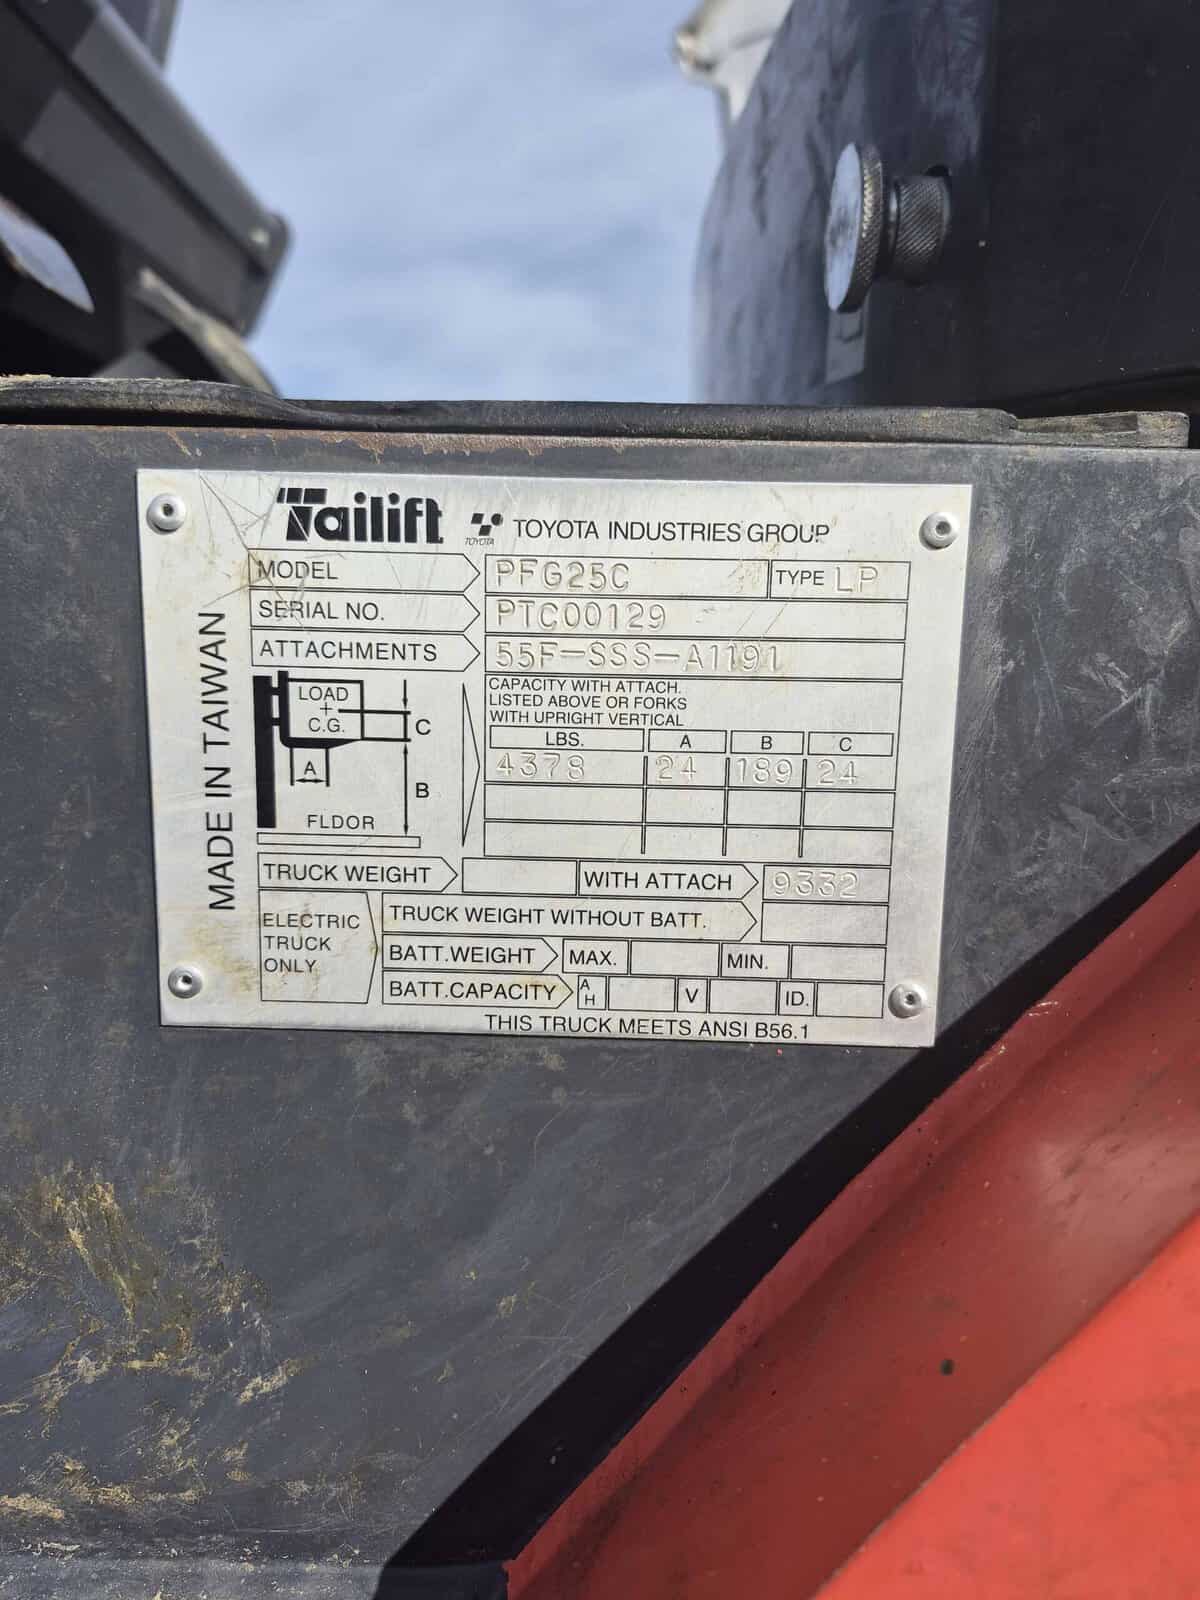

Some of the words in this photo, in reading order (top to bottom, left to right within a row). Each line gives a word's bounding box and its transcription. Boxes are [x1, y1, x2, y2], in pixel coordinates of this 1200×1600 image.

[277, 488, 444, 543] Tailift
[514, 519, 599, 539] TOYOTA
[608, 522, 741, 542] INDUSTRIES
[748, 524, 829, 543] GROUP
[464, 537, 495, 546] TOYOTA
[258, 561, 338, 580] MODEL
[496, 560, 630, 592] PFG25C
[776, 570, 824, 586] TYPE
[834, 566, 879, 593] LP
[259, 600, 339, 620] SERIAL
[346, 603, 384, 620] NO.
[496, 600, 666, 631] PTC00129
[260, 640, 437, 662] ATTACHMENTS
[199, 613, 230, 753] TAIWAN
[489, 678, 568, 693] CAPACITY
[572, 678, 612, 693] WITH
[616, 679, 681, 695] ATTACH.
[298, 686, 349, 701] LOAD
[490, 694, 544, 709] LISTED
[548, 694, 601, 709] ABOVE
[606, 696, 630, 710] OR
[634, 696, 687, 710] FORKS
[308, 718, 345, 733] C.G.
[416, 719, 431, 736] C
[491, 710, 531, 724] WITH
[534, 710, 604, 726] UPRIGHT
[606, 712, 684, 727] VERTICAL
[545, 730, 584, 748] LBS.
[679, 734, 692, 749] A
[760, 736, 773, 750] B
[838, 737, 852, 753] C
[304, 761, 317, 775] A
[496, 752, 586, 782] 4378
[655, 756, 697, 784] 24
[736, 758, 793, 785] 189
[817, 760, 858, 786] 24
[204, 768, 232, 798] IN
[416, 783, 429, 798] B
[206, 813, 235, 910] MADE
[264, 863, 338, 882] TRUCK
[344, 866, 432, 884] WEIGHT
[584, 872, 641, 890] WITH
[646, 872, 732, 891] ATTACH
[772, 872, 858, 898] 9332
[263, 912, 360, 929] ELECTRIC
[390, 906, 458, 922] TRUCK
[464, 906, 544, 925] WEIGHT
[551, 908, 644, 927] WITHOUT
[650, 911, 707, 929] BATT.
[264, 936, 331, 952] TRUCK
[389, 945, 536, 964] BATT.WEIGHT
[569, 950, 617, 966] MAX.
[728, 954, 768, 970] MIN.
[264, 958, 318, 973] ONLY
[389, 982, 556, 1000] BATT.CAPACITY
[580, 980, 590, 991] A
[584, 994, 596, 1006] H
[685, 988, 698, 1004] V
[785, 990, 809, 1007] ID.
[485, 1014, 533, 1033] THIS
[540, 1015, 612, 1034] TRUCK
[618, 1018, 692, 1036] MEETS
[698, 1020, 748, 1038] ANSI
[755, 1022, 808, 1040] B56.1
